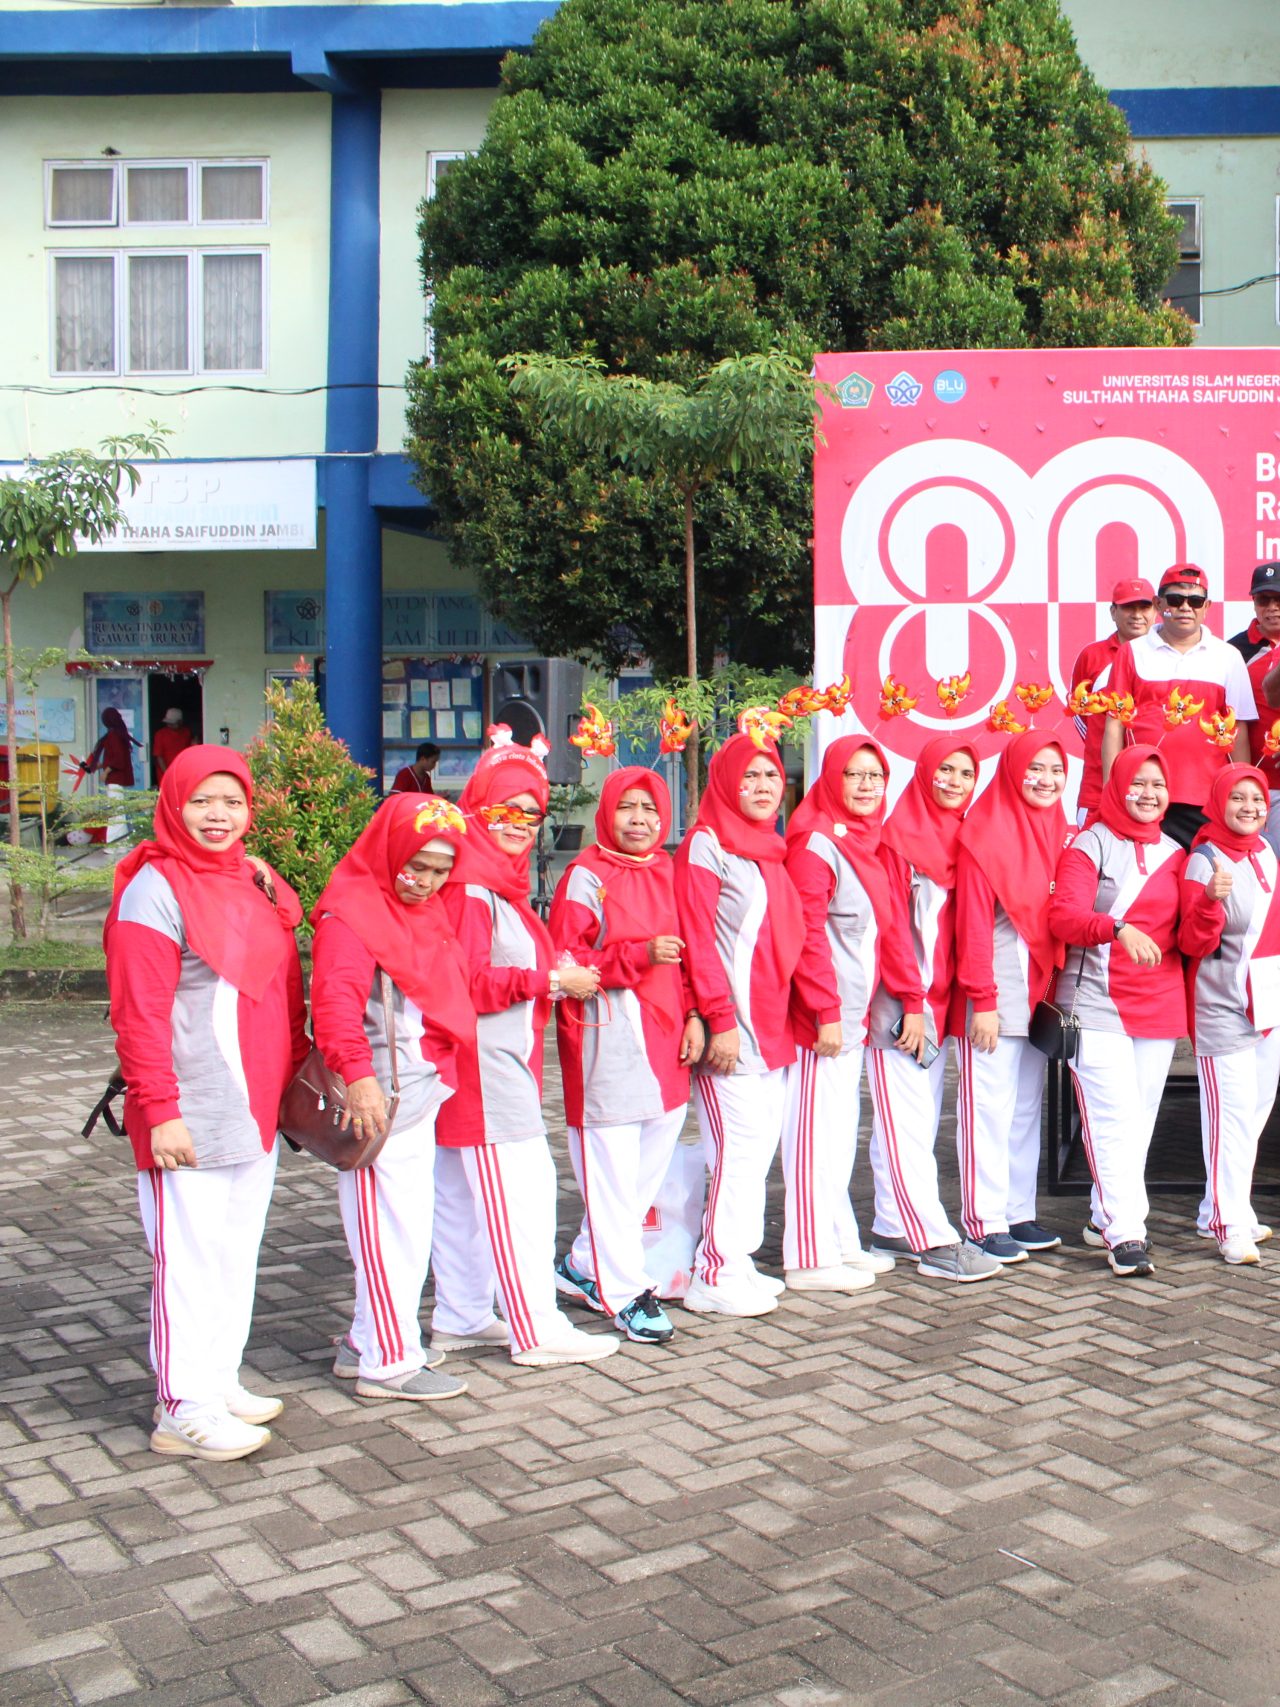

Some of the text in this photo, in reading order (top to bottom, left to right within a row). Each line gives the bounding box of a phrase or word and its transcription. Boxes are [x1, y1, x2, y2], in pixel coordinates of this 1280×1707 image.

[1103, 375, 1189, 387] UNIVERSITAS
[1192, 375, 1233, 387] ISLAM
[1062, 390, 1134, 404] SULTHAN
[1137, 390, 1190, 403] THAHA
[1192, 389, 1274, 403] SAIFUDDIN
[121, 526, 171, 538] THAHA
[174, 525, 256, 538] SAIFUDDIN
[259, 524, 305, 537] JAMBI
